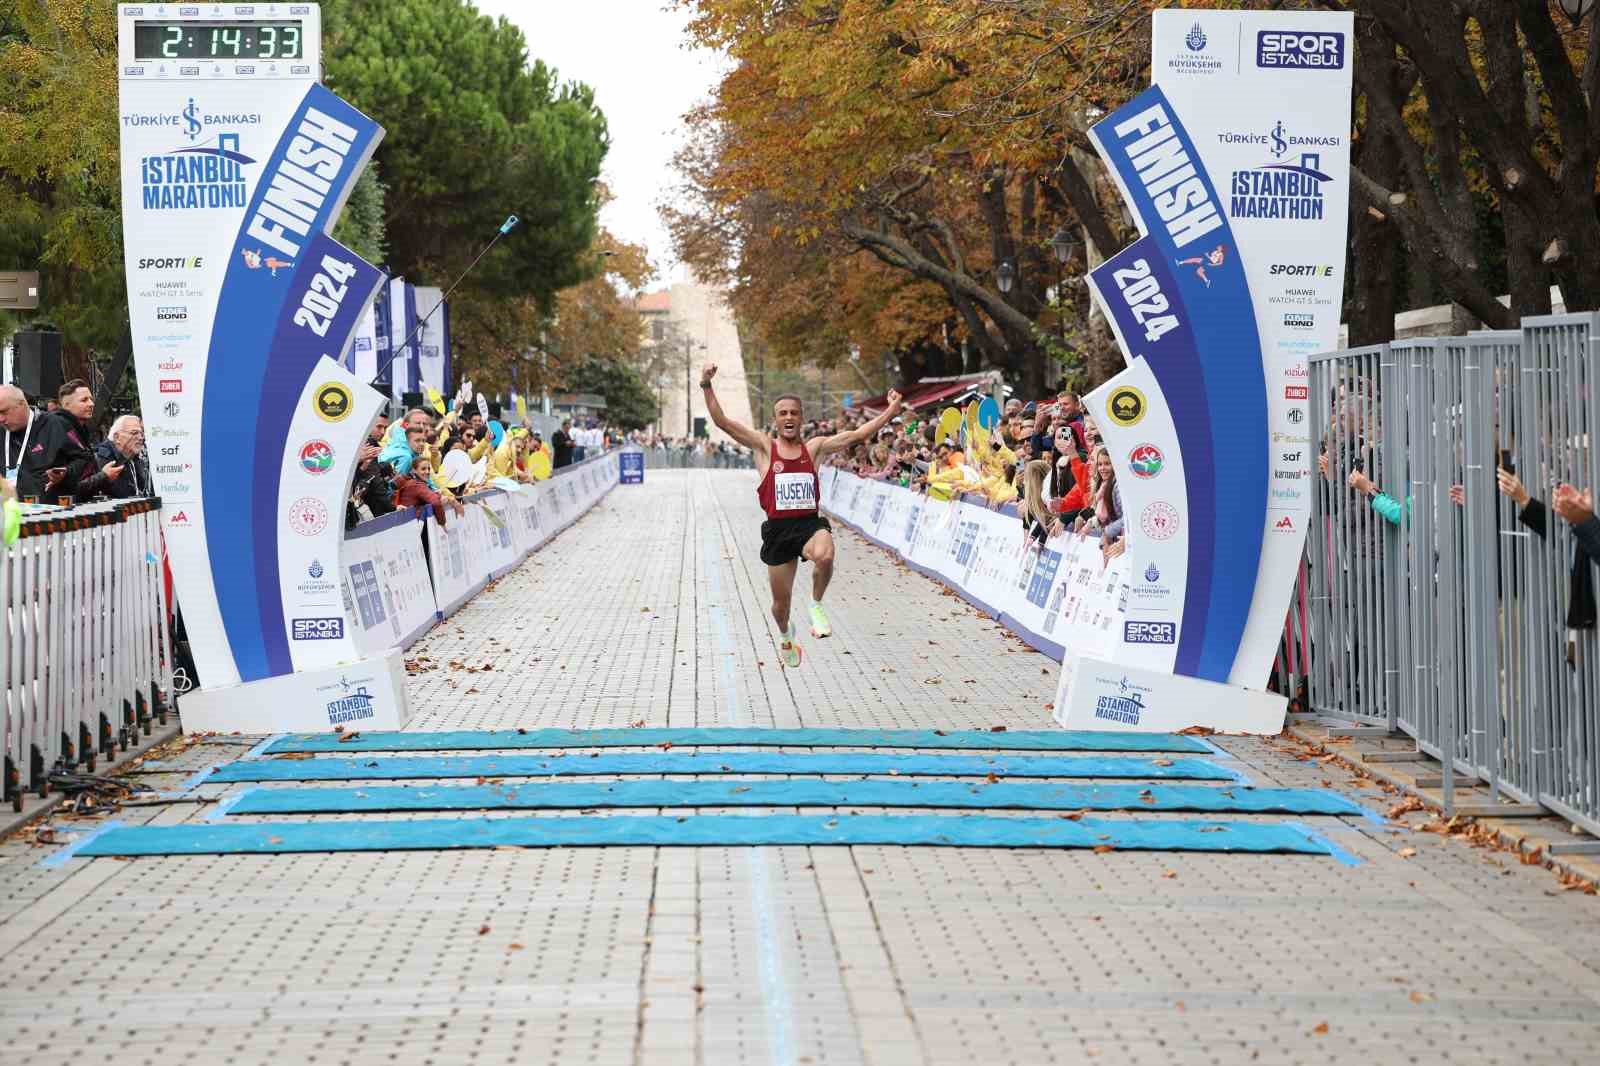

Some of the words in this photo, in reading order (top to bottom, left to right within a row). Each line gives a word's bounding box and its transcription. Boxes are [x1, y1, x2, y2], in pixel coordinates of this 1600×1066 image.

[1261, 34, 1338, 54] SPOR
[122, 113, 180, 126] TÜRKİYE
[203, 114, 261, 125] BANKASI
[1217, 132, 1269, 144] TÜRKİYE
[1289, 136, 1340, 146] BANKASI
[247, 106, 359, 258] FINISH
[1114, 102, 1224, 249] FINISH
[143, 183, 247, 210] MARATONU
[1231, 196, 1323, 220] MARATHON
[138, 256, 203, 270] SPORTIVE
[1269, 264, 1334, 277] SPORTIVE
[293, 254, 358, 338] 2024
[1112, 258, 1180, 343] 2024
[161, 445, 180, 455] saf
[1282, 451, 1303, 462] saf
[156, 463, 184, 473] karnaval
[776, 481, 816, 501] HUSEYIN
[294, 619, 340, 632] SPOR
[1127, 622, 1173, 635] SPOR
[329, 707, 374, 725] MARATONU
[1095, 707, 1140, 726] MARATONU
